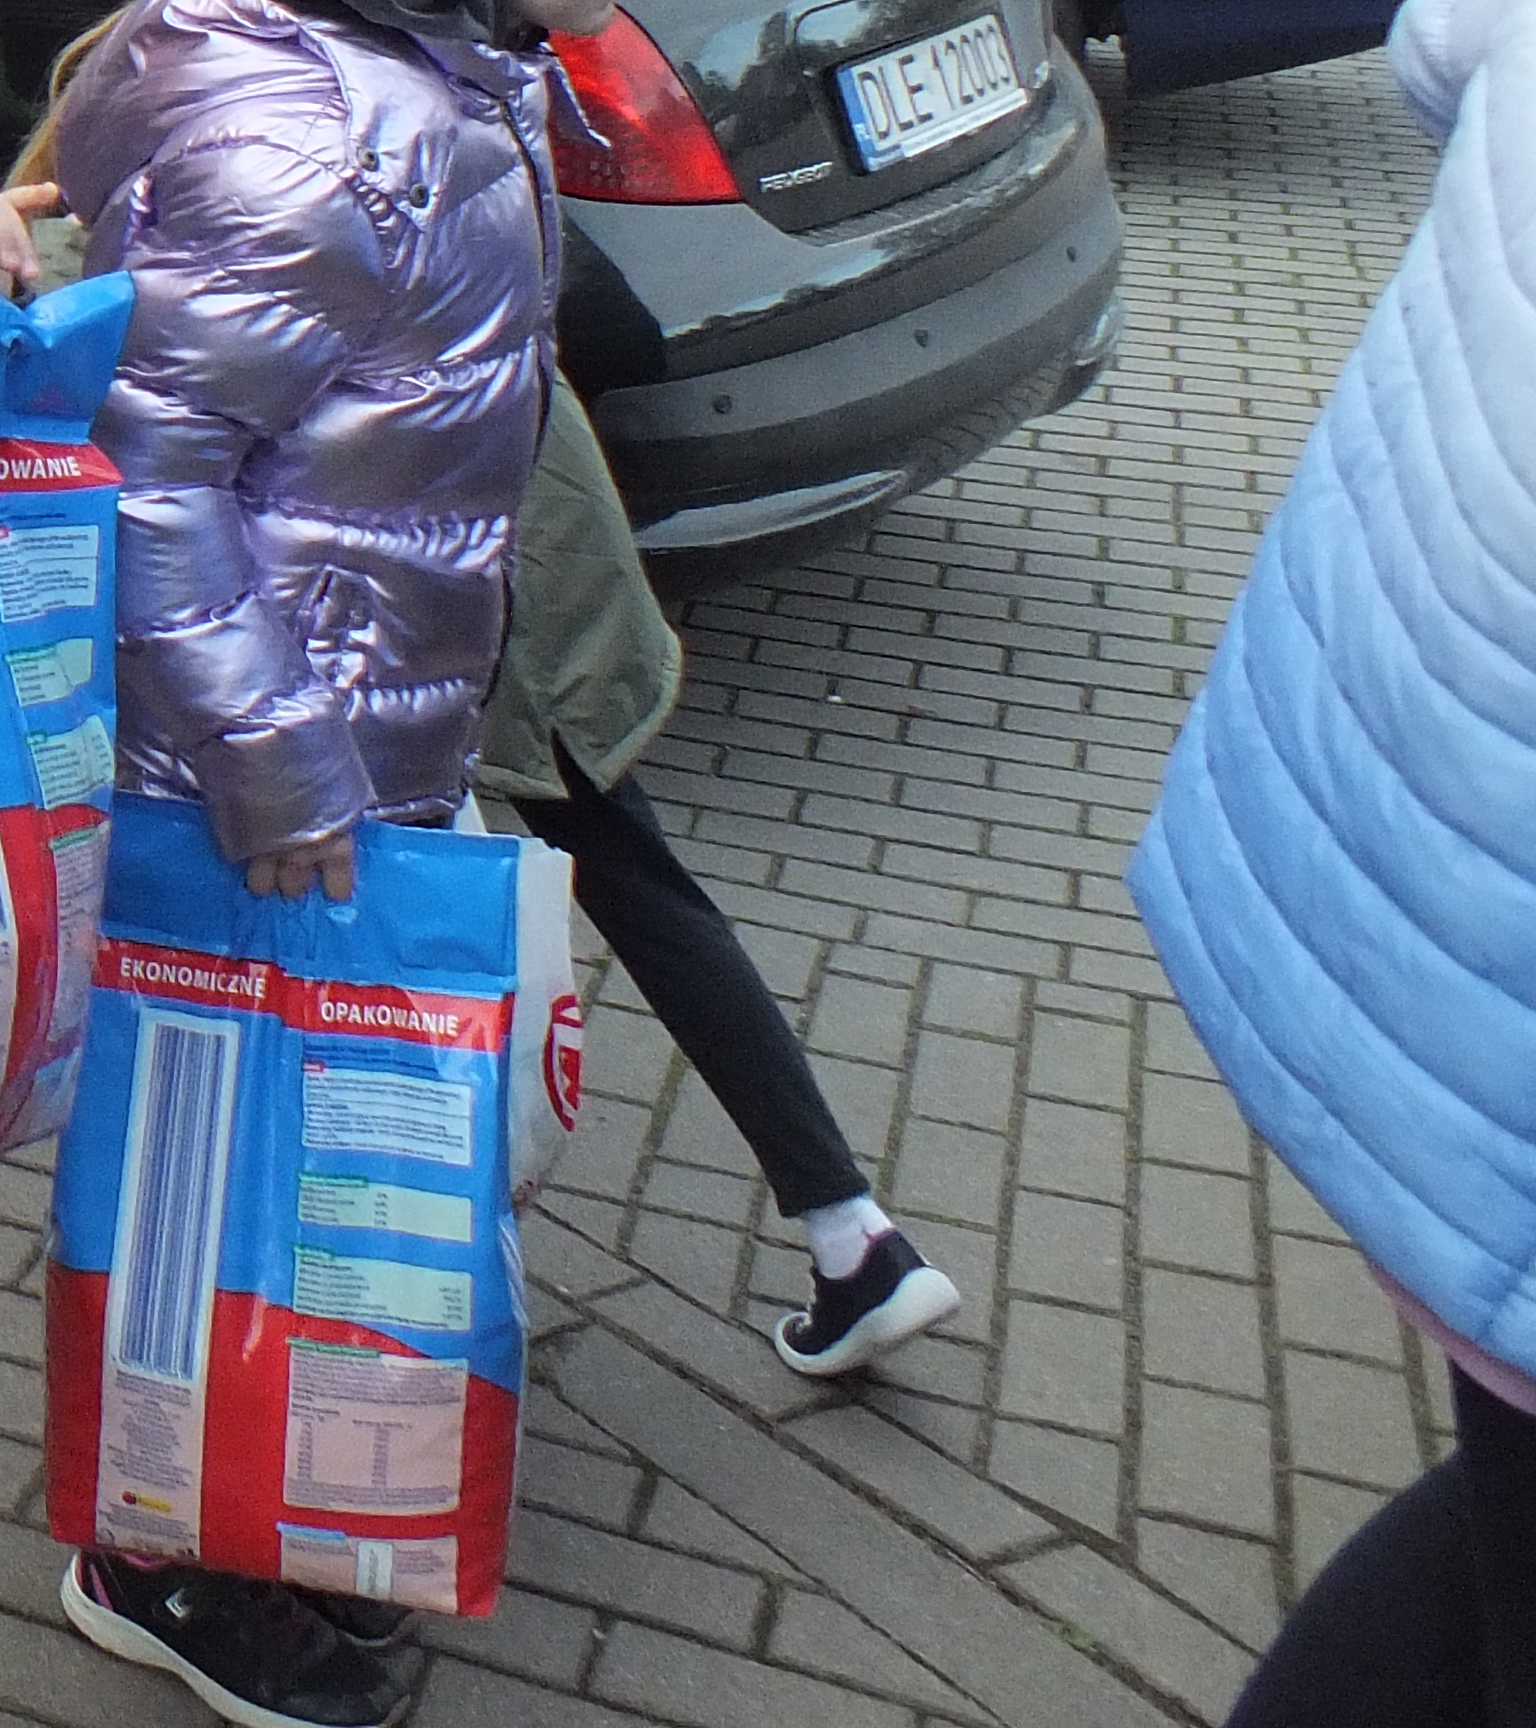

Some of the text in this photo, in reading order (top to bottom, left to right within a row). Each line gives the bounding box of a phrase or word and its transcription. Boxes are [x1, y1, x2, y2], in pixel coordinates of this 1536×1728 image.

[857, 54, 934, 140] DLE
[759, 160, 834, 193] PEUGEOT
[119, 956, 267, 1000] EKONOMICZNE
[320, 1000, 460, 1038] OPAKOWANIE
